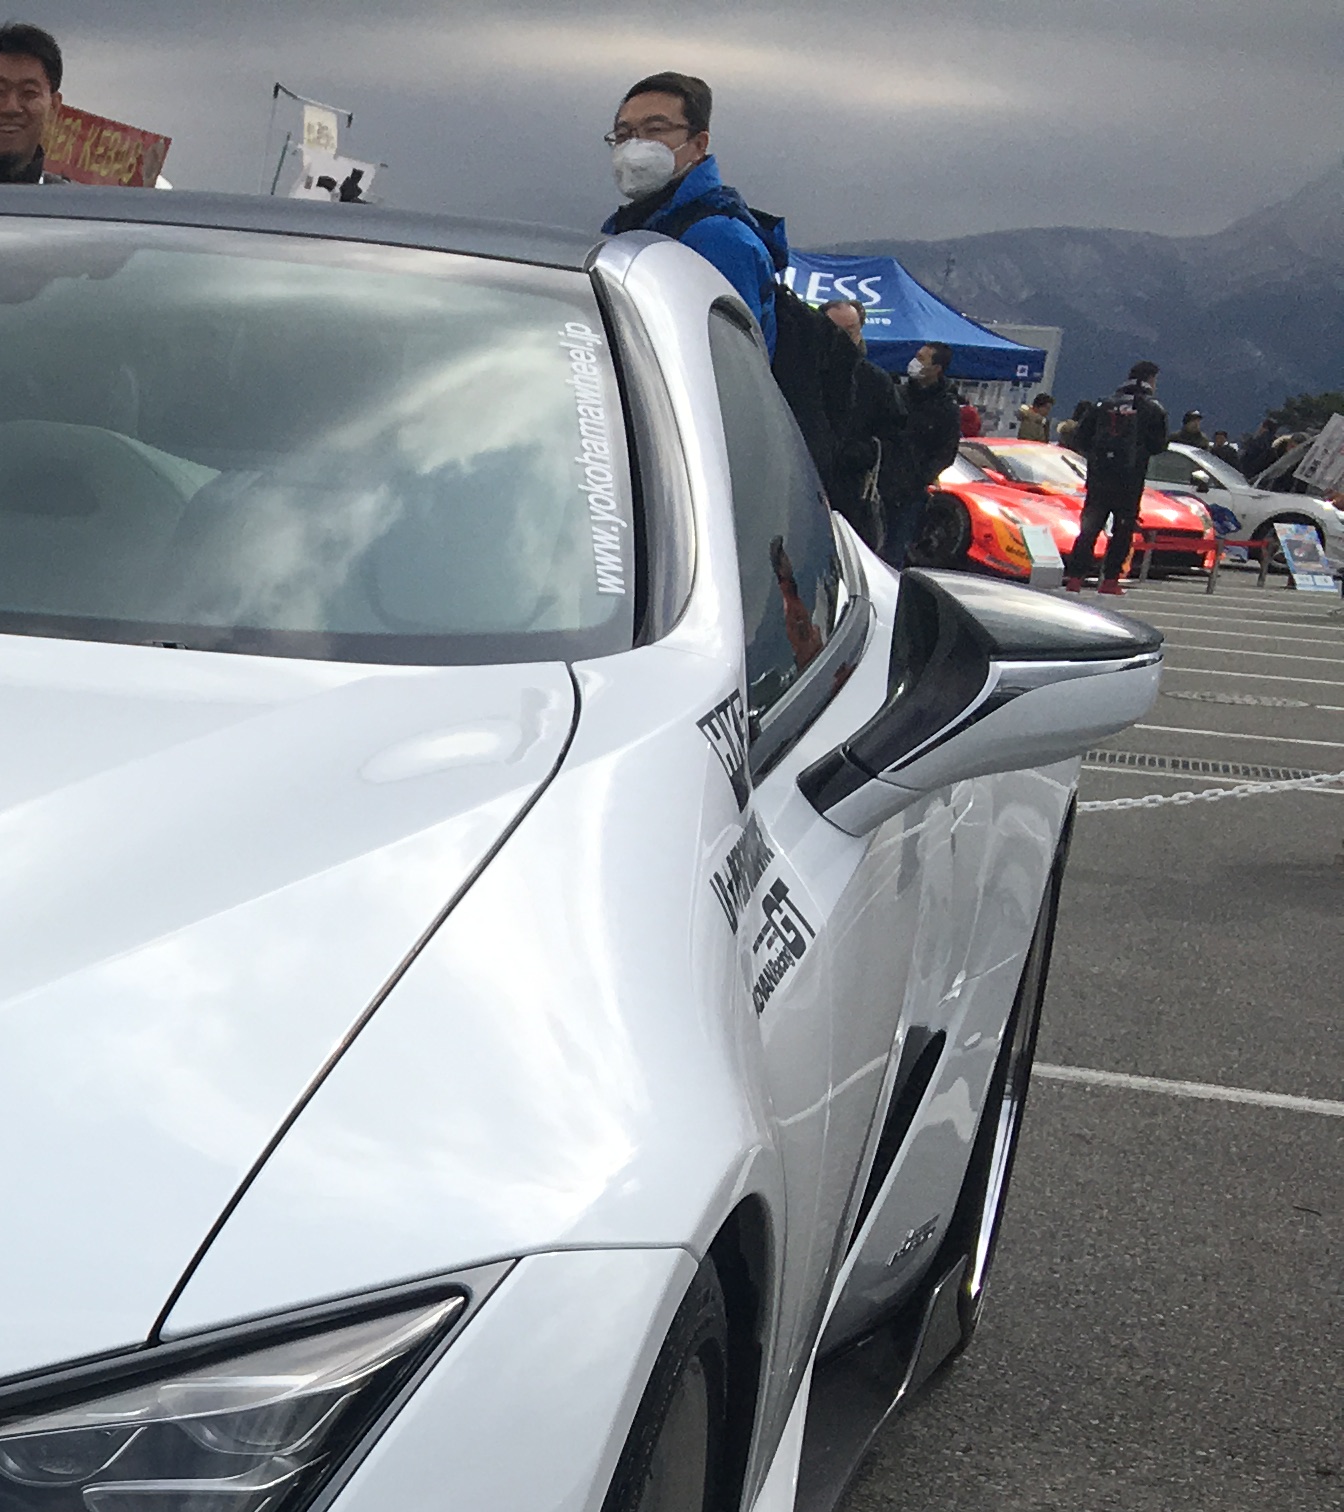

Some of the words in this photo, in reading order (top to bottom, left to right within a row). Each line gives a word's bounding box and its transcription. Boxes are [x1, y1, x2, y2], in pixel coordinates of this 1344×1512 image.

[778, 266, 882, 306] LESS
[558, 321, 628, 595] www.yokohamawheel.jp
[761, 877, 816, 960] GT
